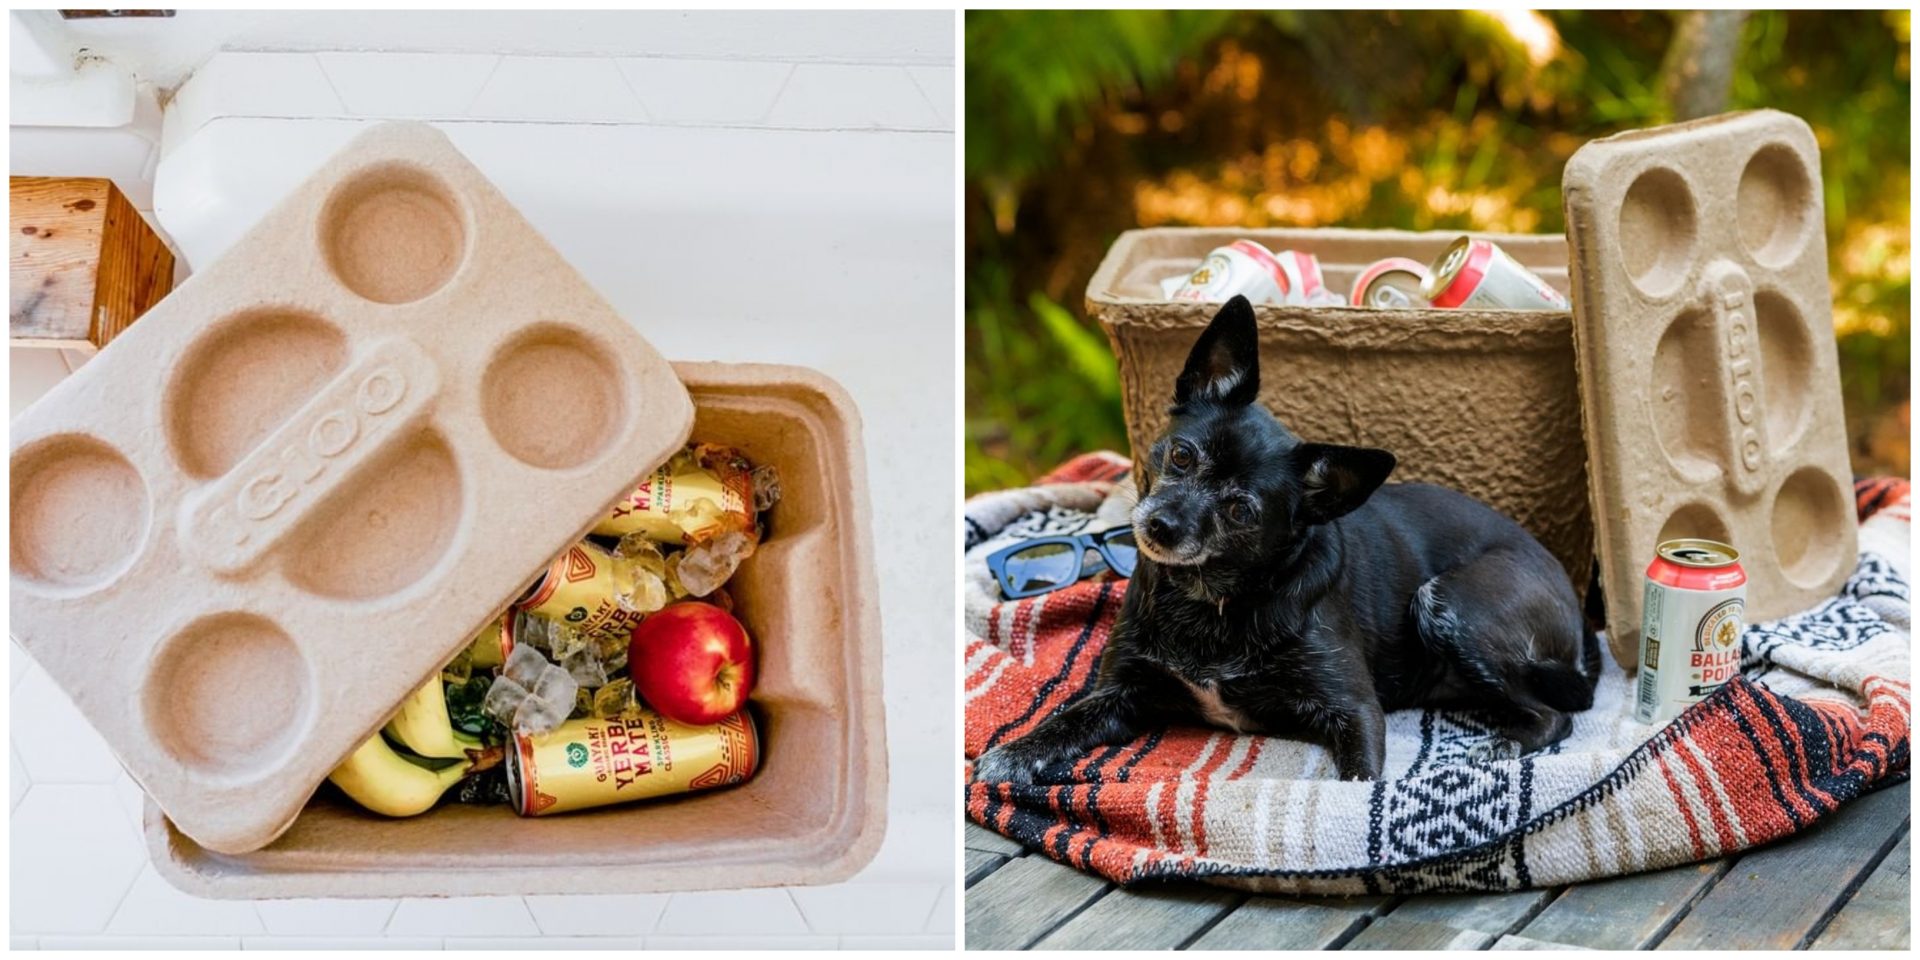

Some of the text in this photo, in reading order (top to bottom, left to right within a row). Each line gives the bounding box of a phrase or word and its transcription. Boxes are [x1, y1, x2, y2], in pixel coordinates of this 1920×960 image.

[1724, 291, 1760, 474] IGLOO
[210, 361, 407, 547] IGLOO
[633, 475, 652, 511] MA
[614, 612, 646, 641] ATE
[604, 712, 634, 791] YERBA
[626, 717, 653, 778] MATE
[660, 734, 672, 772] CLASSIC
